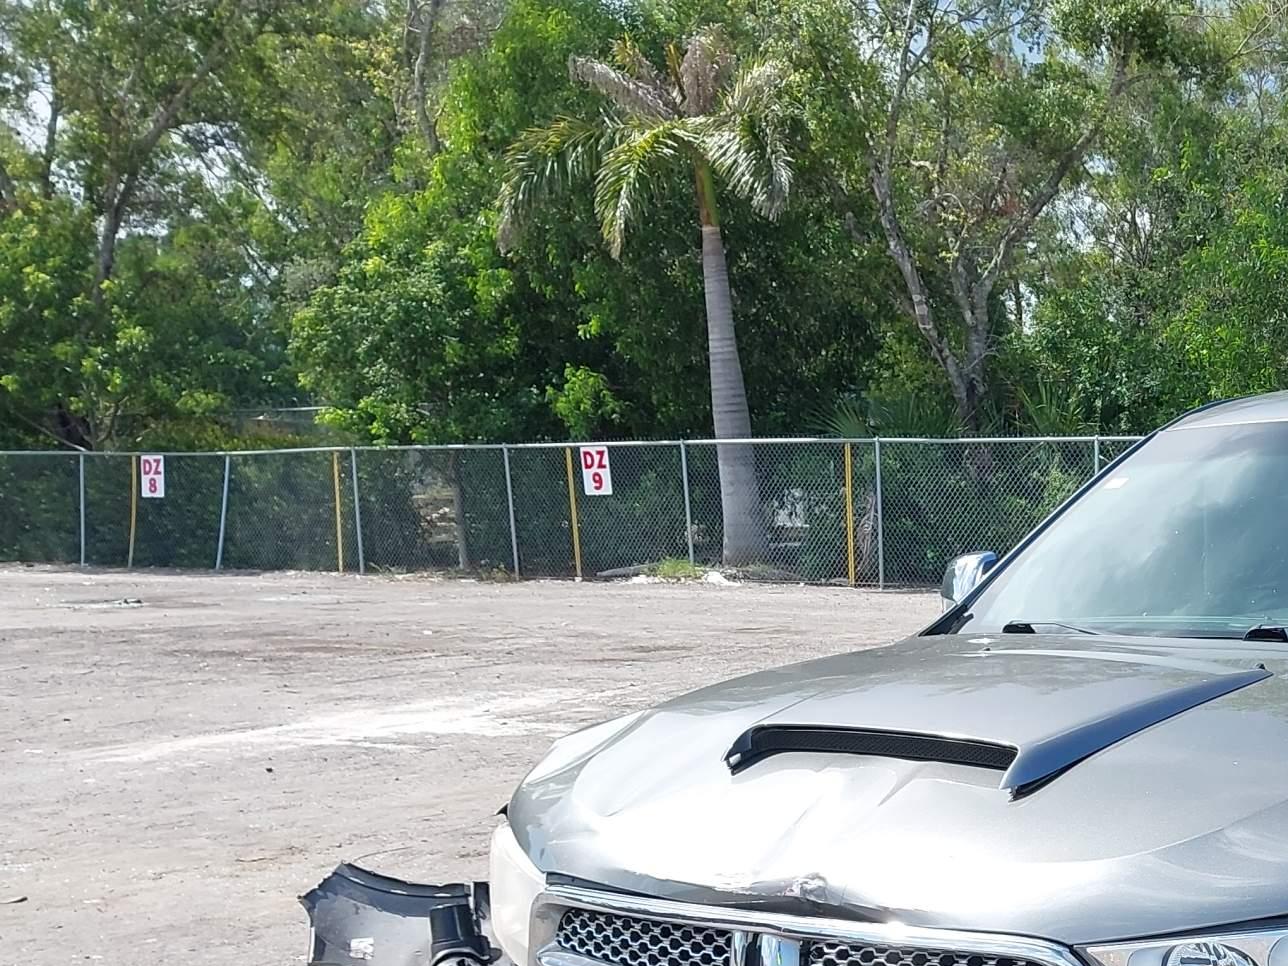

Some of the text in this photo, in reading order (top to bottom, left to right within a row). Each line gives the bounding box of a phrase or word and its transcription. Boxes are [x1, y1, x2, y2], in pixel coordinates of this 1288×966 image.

[143, 459, 162, 476] DZ
[583, 450, 607, 469] DZ
[149, 477, 157, 494] 8
[592, 472, 603, 491] 9
